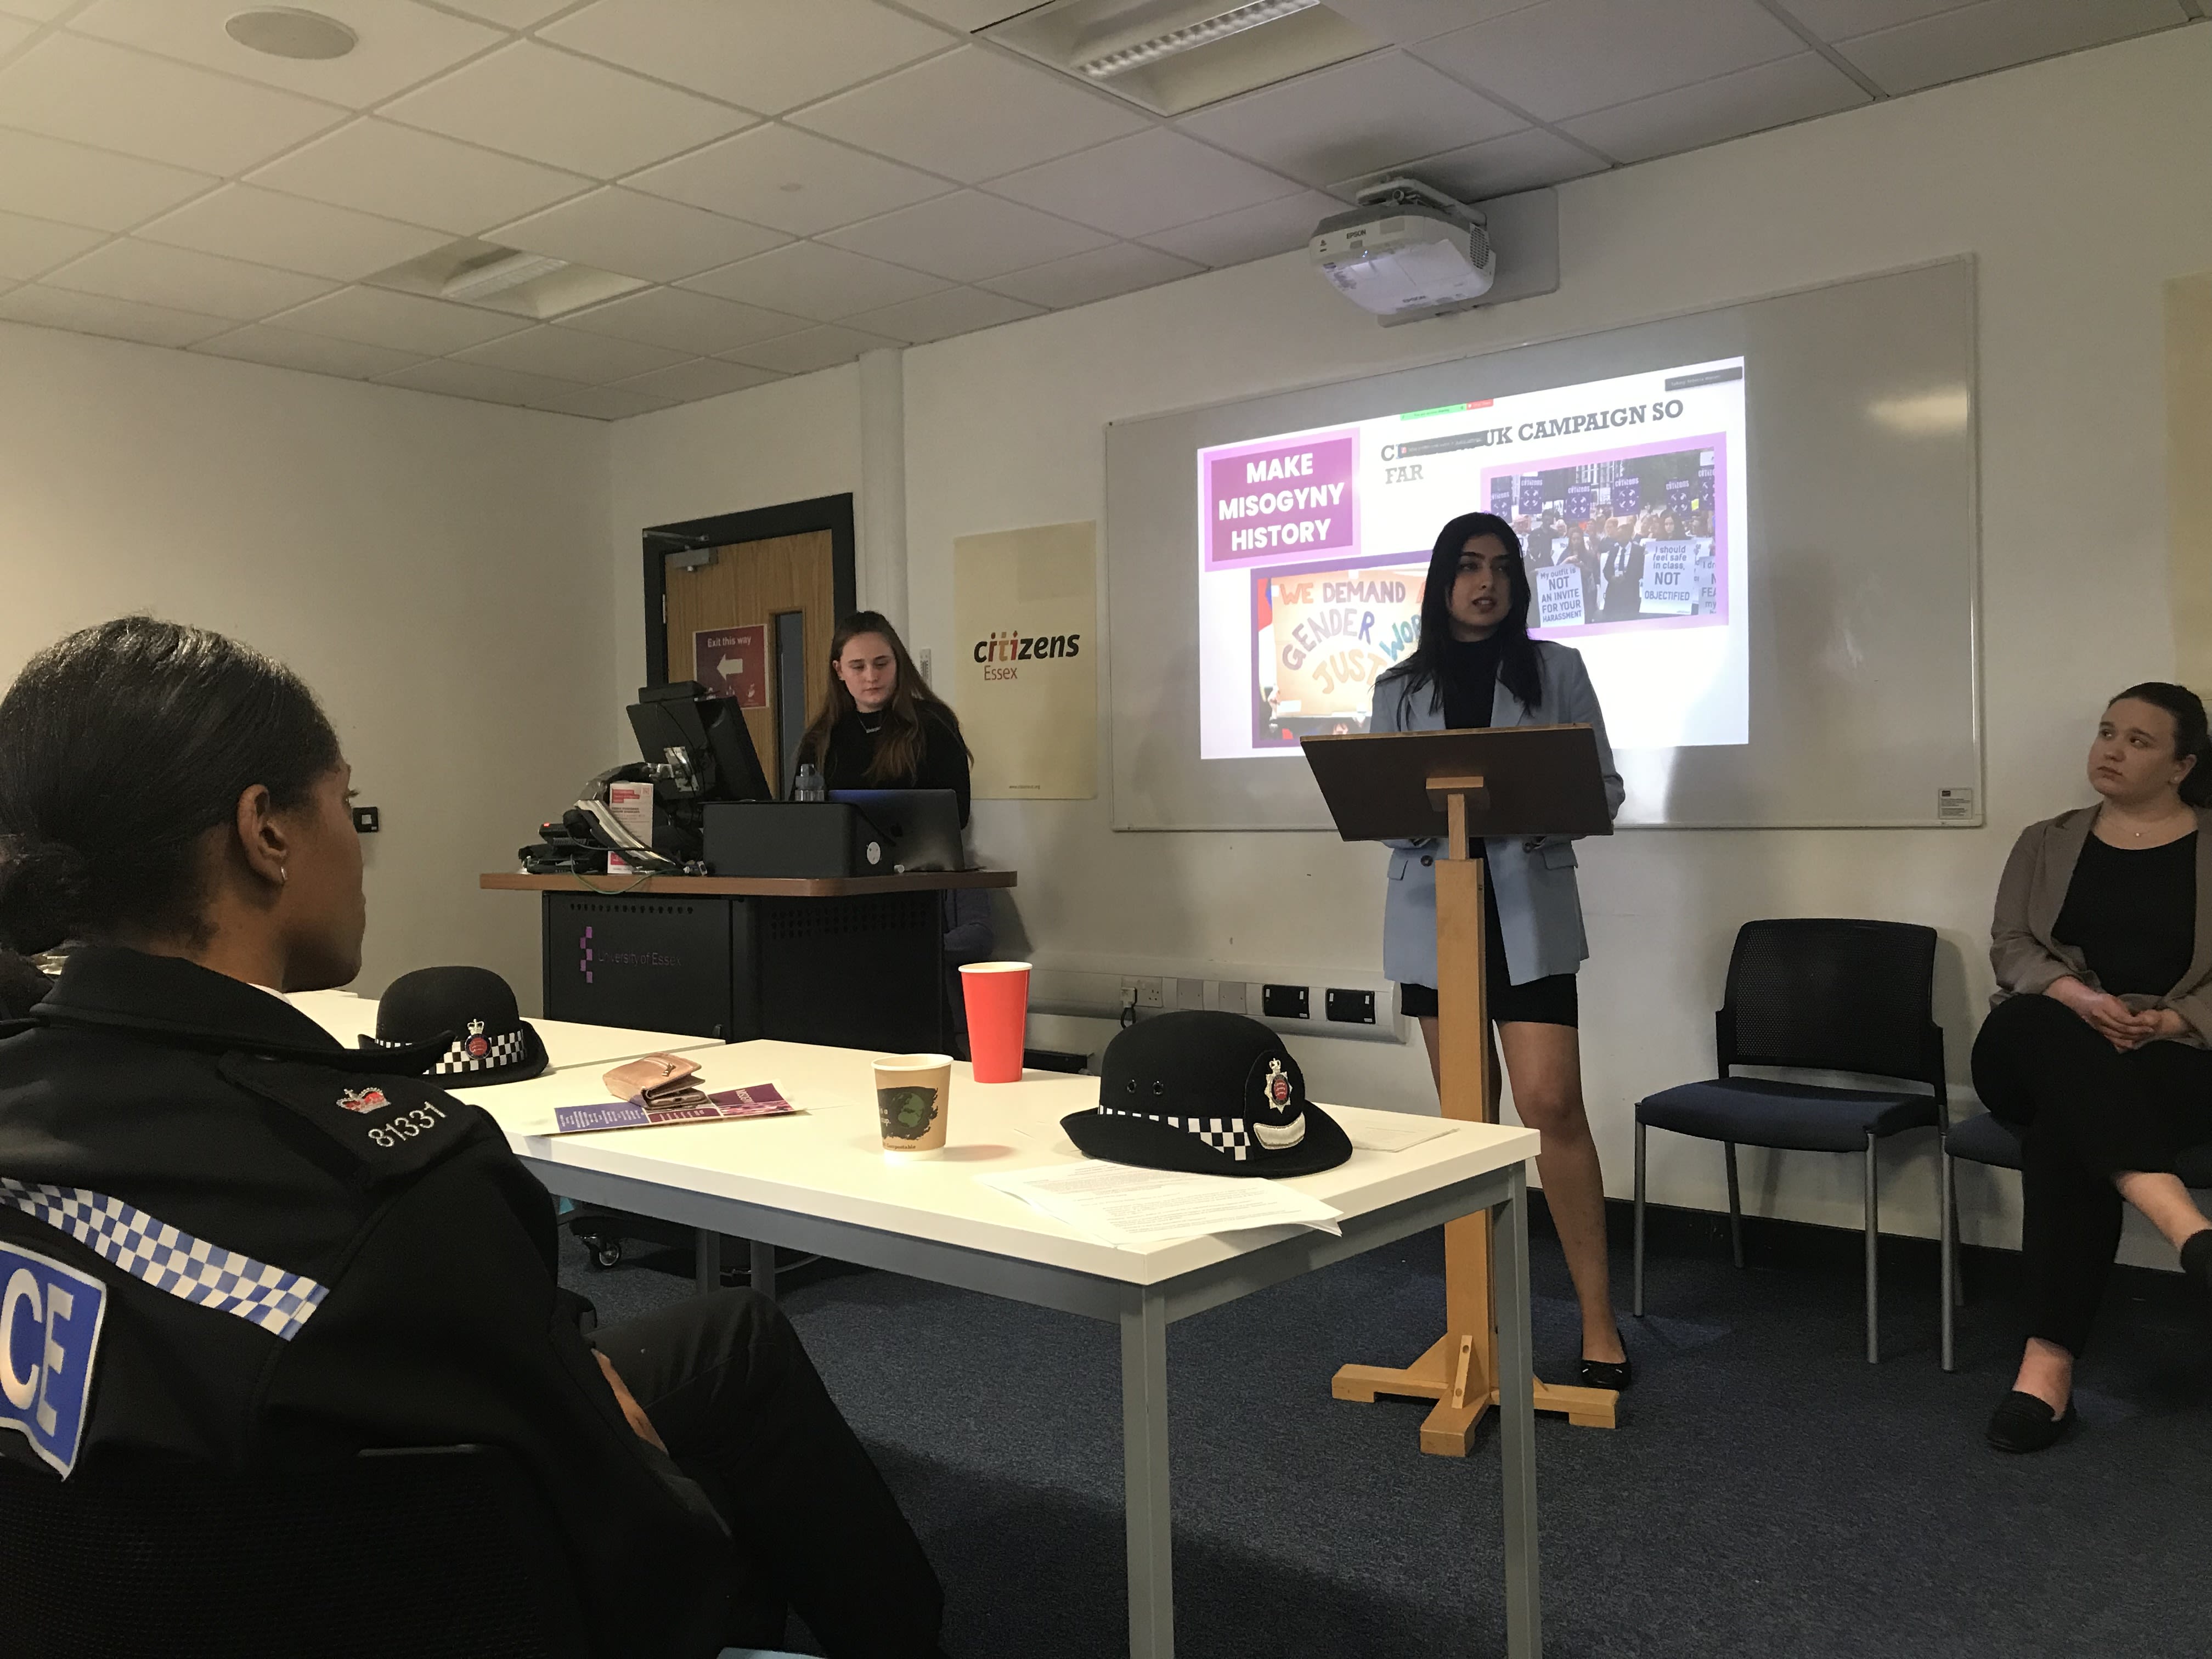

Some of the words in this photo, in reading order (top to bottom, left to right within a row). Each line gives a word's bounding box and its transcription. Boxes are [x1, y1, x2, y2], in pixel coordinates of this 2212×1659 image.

[1346, 229, 1366, 240] EPSON
[1518, 405, 1647, 441] CAMPAIGN
[1652, 399, 1684, 421] SO
[1246, 453, 1313, 484] MAKE
[1385, 464, 1424, 484] FAR
[1218, 482, 1345, 521] MISOGYNY
[1232, 518, 1331, 551] HISTORY
[1660, 545, 1686, 554] should
[1670, 553, 1687, 561] safe
[1541, 572, 1549, 580] My
[1551, 568, 1568, 577] outfit
[1655, 572, 1681, 585] NOT
[1548, 576, 1570, 591] NOT
[1279, 582, 1314, 606] WE
[1323, 581, 1406, 604] DEMAND
[1542, 592, 1552, 603] AN
[1554, 588, 1580, 601] INVITE
[1644, 590, 1690, 601] OBJECTIFIED
[1542, 603, 1558, 614] FOR
[1560, 599, 1581, 611] YOUR
[1542, 610, 1582, 623] HARASSMENT
[707, 637, 721, 647] Exit
[723, 636, 736, 646] this
[737, 636, 752, 646] way
[1282, 608, 1375, 670] GENDER
[1379, 614, 1421, 662] WOR
[974, 630, 1080, 663] citizens
[984, 665, 1018, 680] Essex
[1312, 648, 1387, 695] JUST
[598, 949, 638, 966] Unersity
[641, 952, 650, 964] of
[652, 952, 681, 966] Essex
[368, 1101, 447, 1147] 81331
